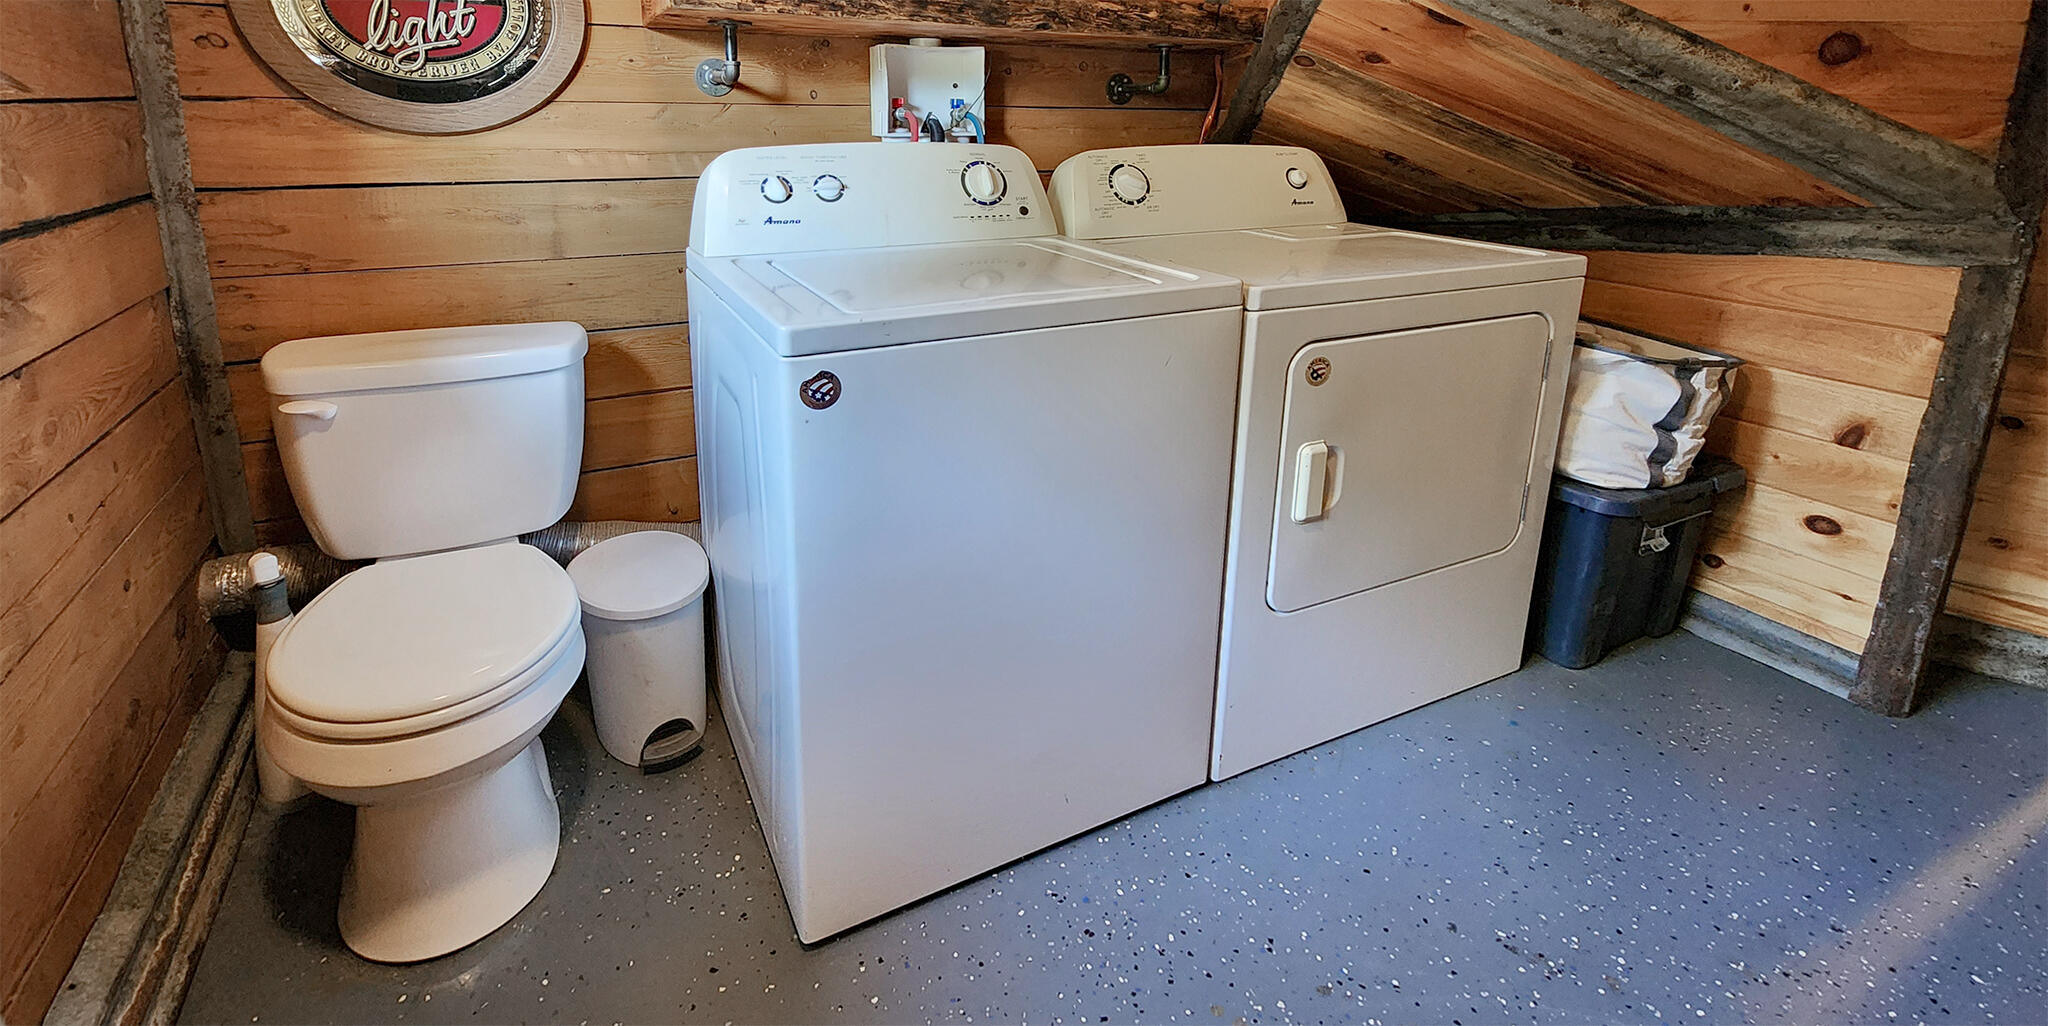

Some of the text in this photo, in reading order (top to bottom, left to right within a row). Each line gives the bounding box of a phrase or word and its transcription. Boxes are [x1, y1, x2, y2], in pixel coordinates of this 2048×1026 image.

[301, 0, 351, 52] NEKEN
[355, 48, 481, 79] BROUERIJEN
[363, 0, 477, 70] light
[762, 215, 802, 227] Amana
